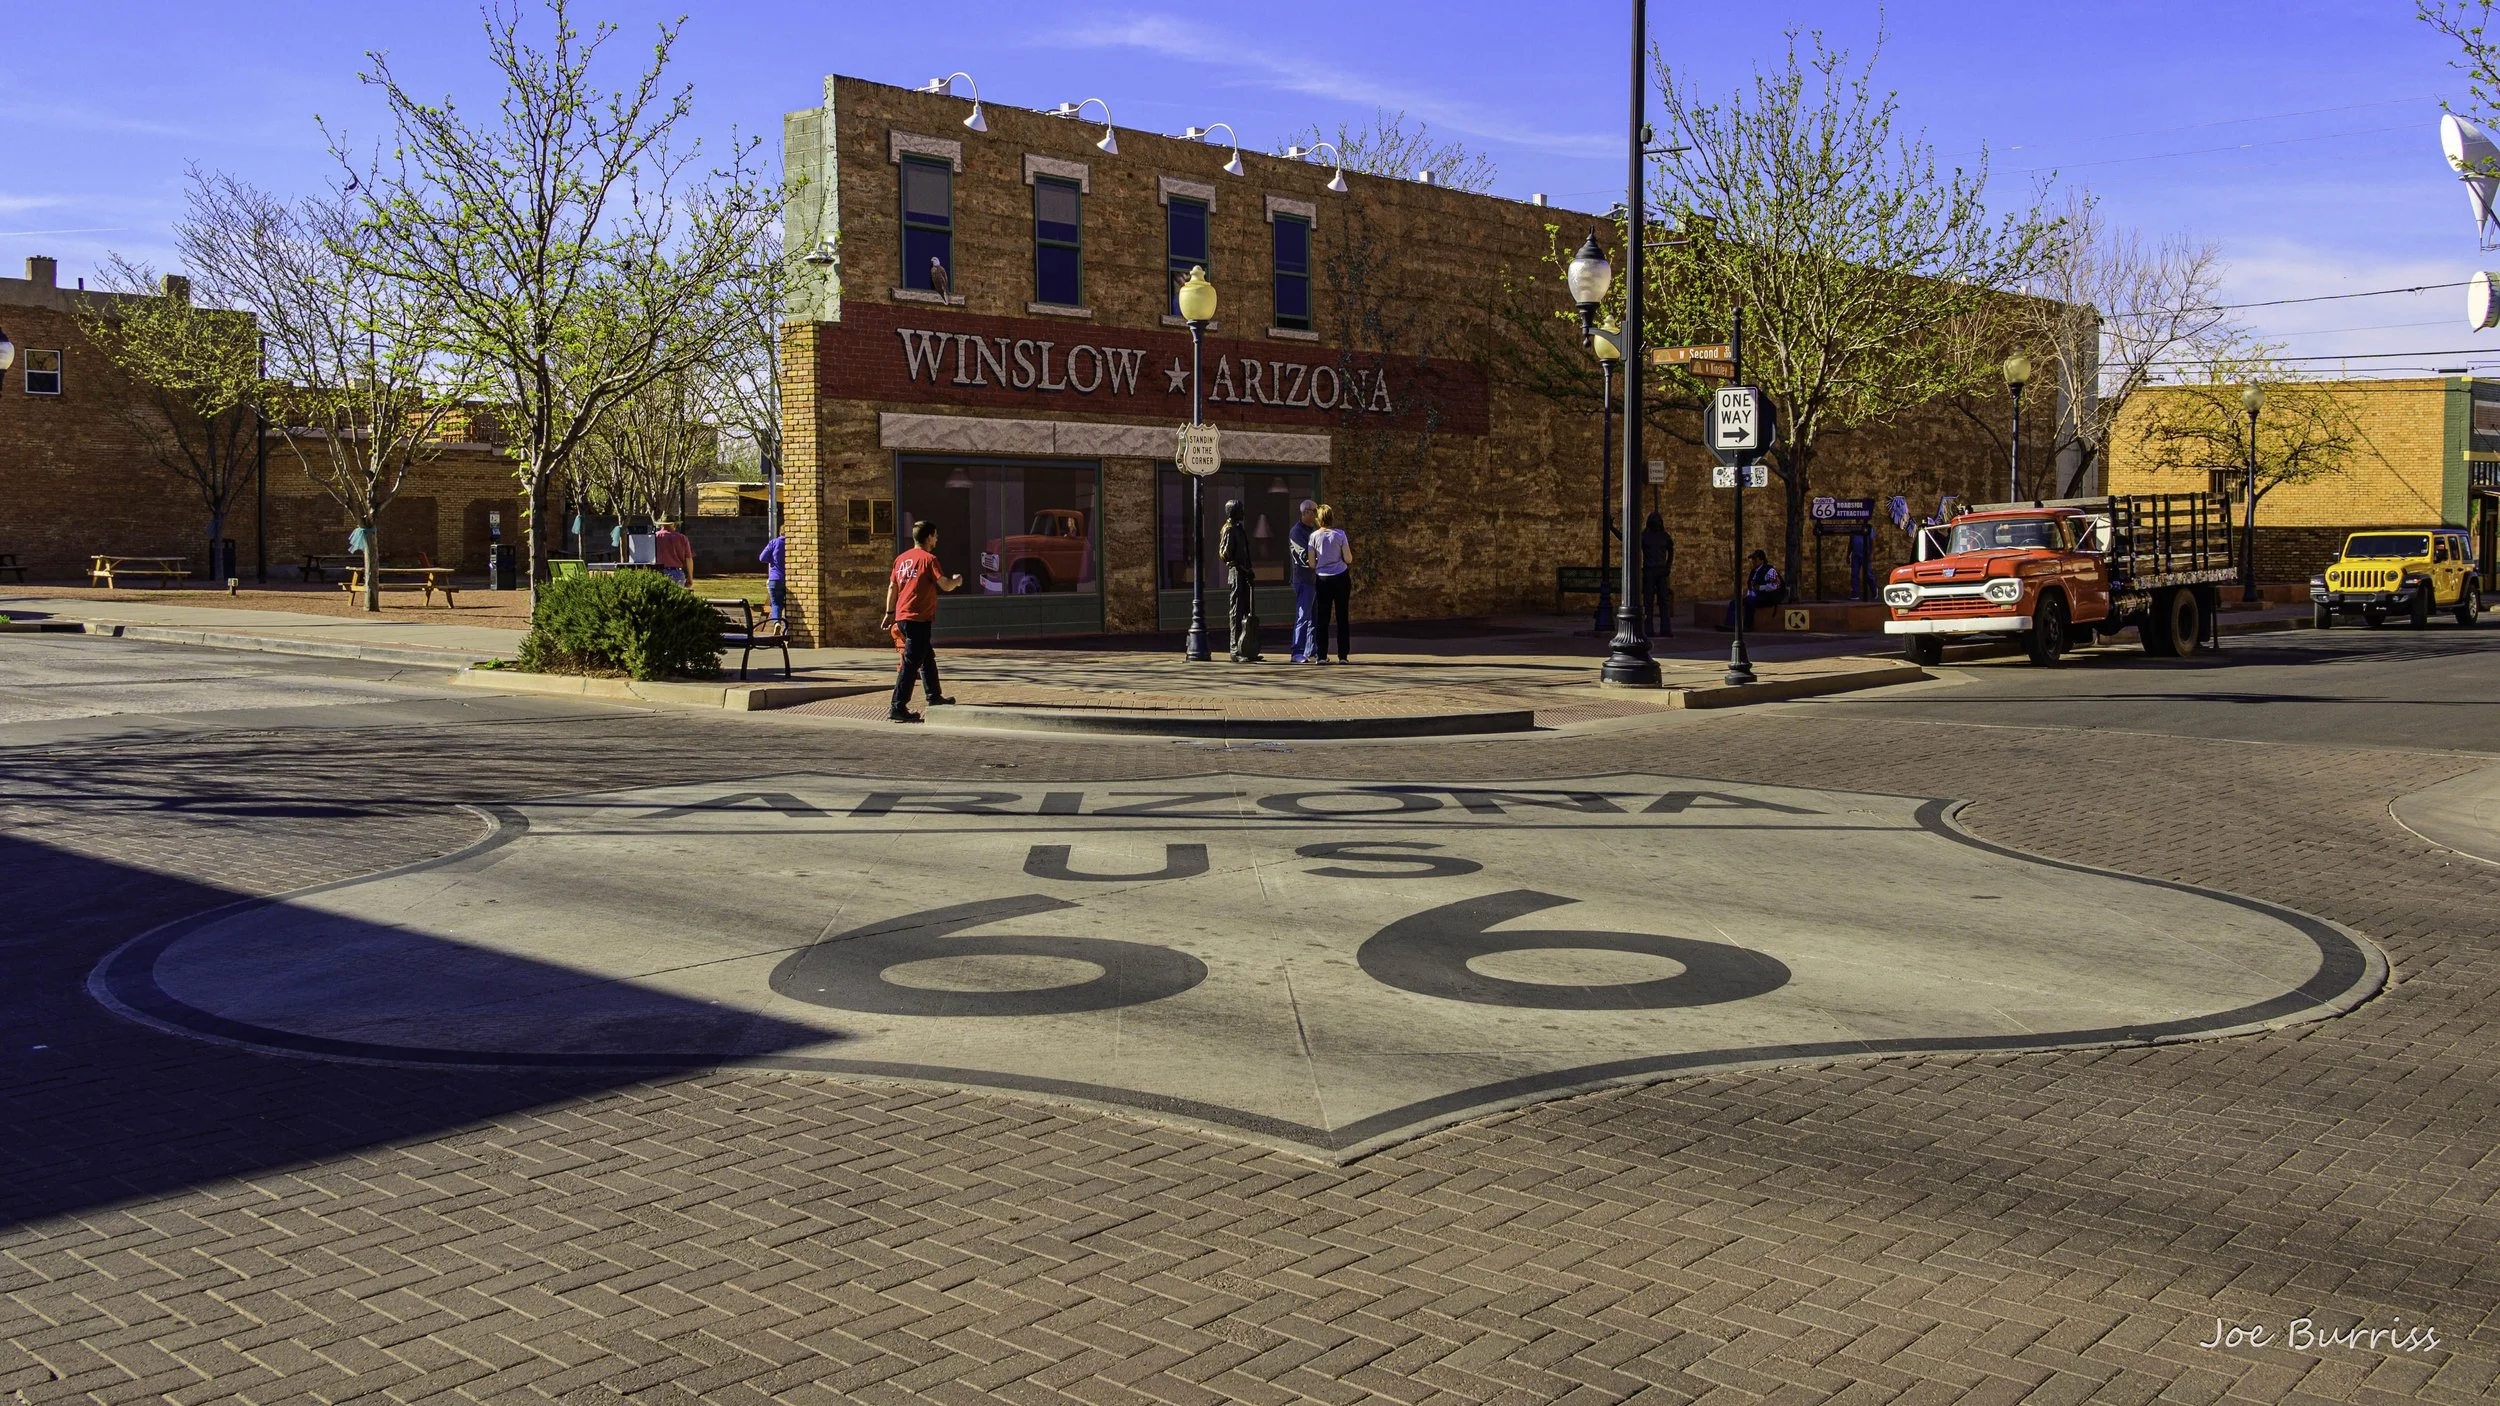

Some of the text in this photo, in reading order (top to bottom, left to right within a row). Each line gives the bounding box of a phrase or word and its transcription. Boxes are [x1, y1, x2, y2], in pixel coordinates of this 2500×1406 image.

[1680, 351, 1685, 359] W
[1689, 348, 1719, 359] Second
[896, 327, 1393, 413] WINSLOW ARIZONA
[1722, 394, 1751, 407] ONE
[1721, 410, 1752, 424] WAY
[1202, 446, 1212, 454] THE
[1816, 505, 1832, 517] 66
[631, 790, 1831, 819] ARIZONA
